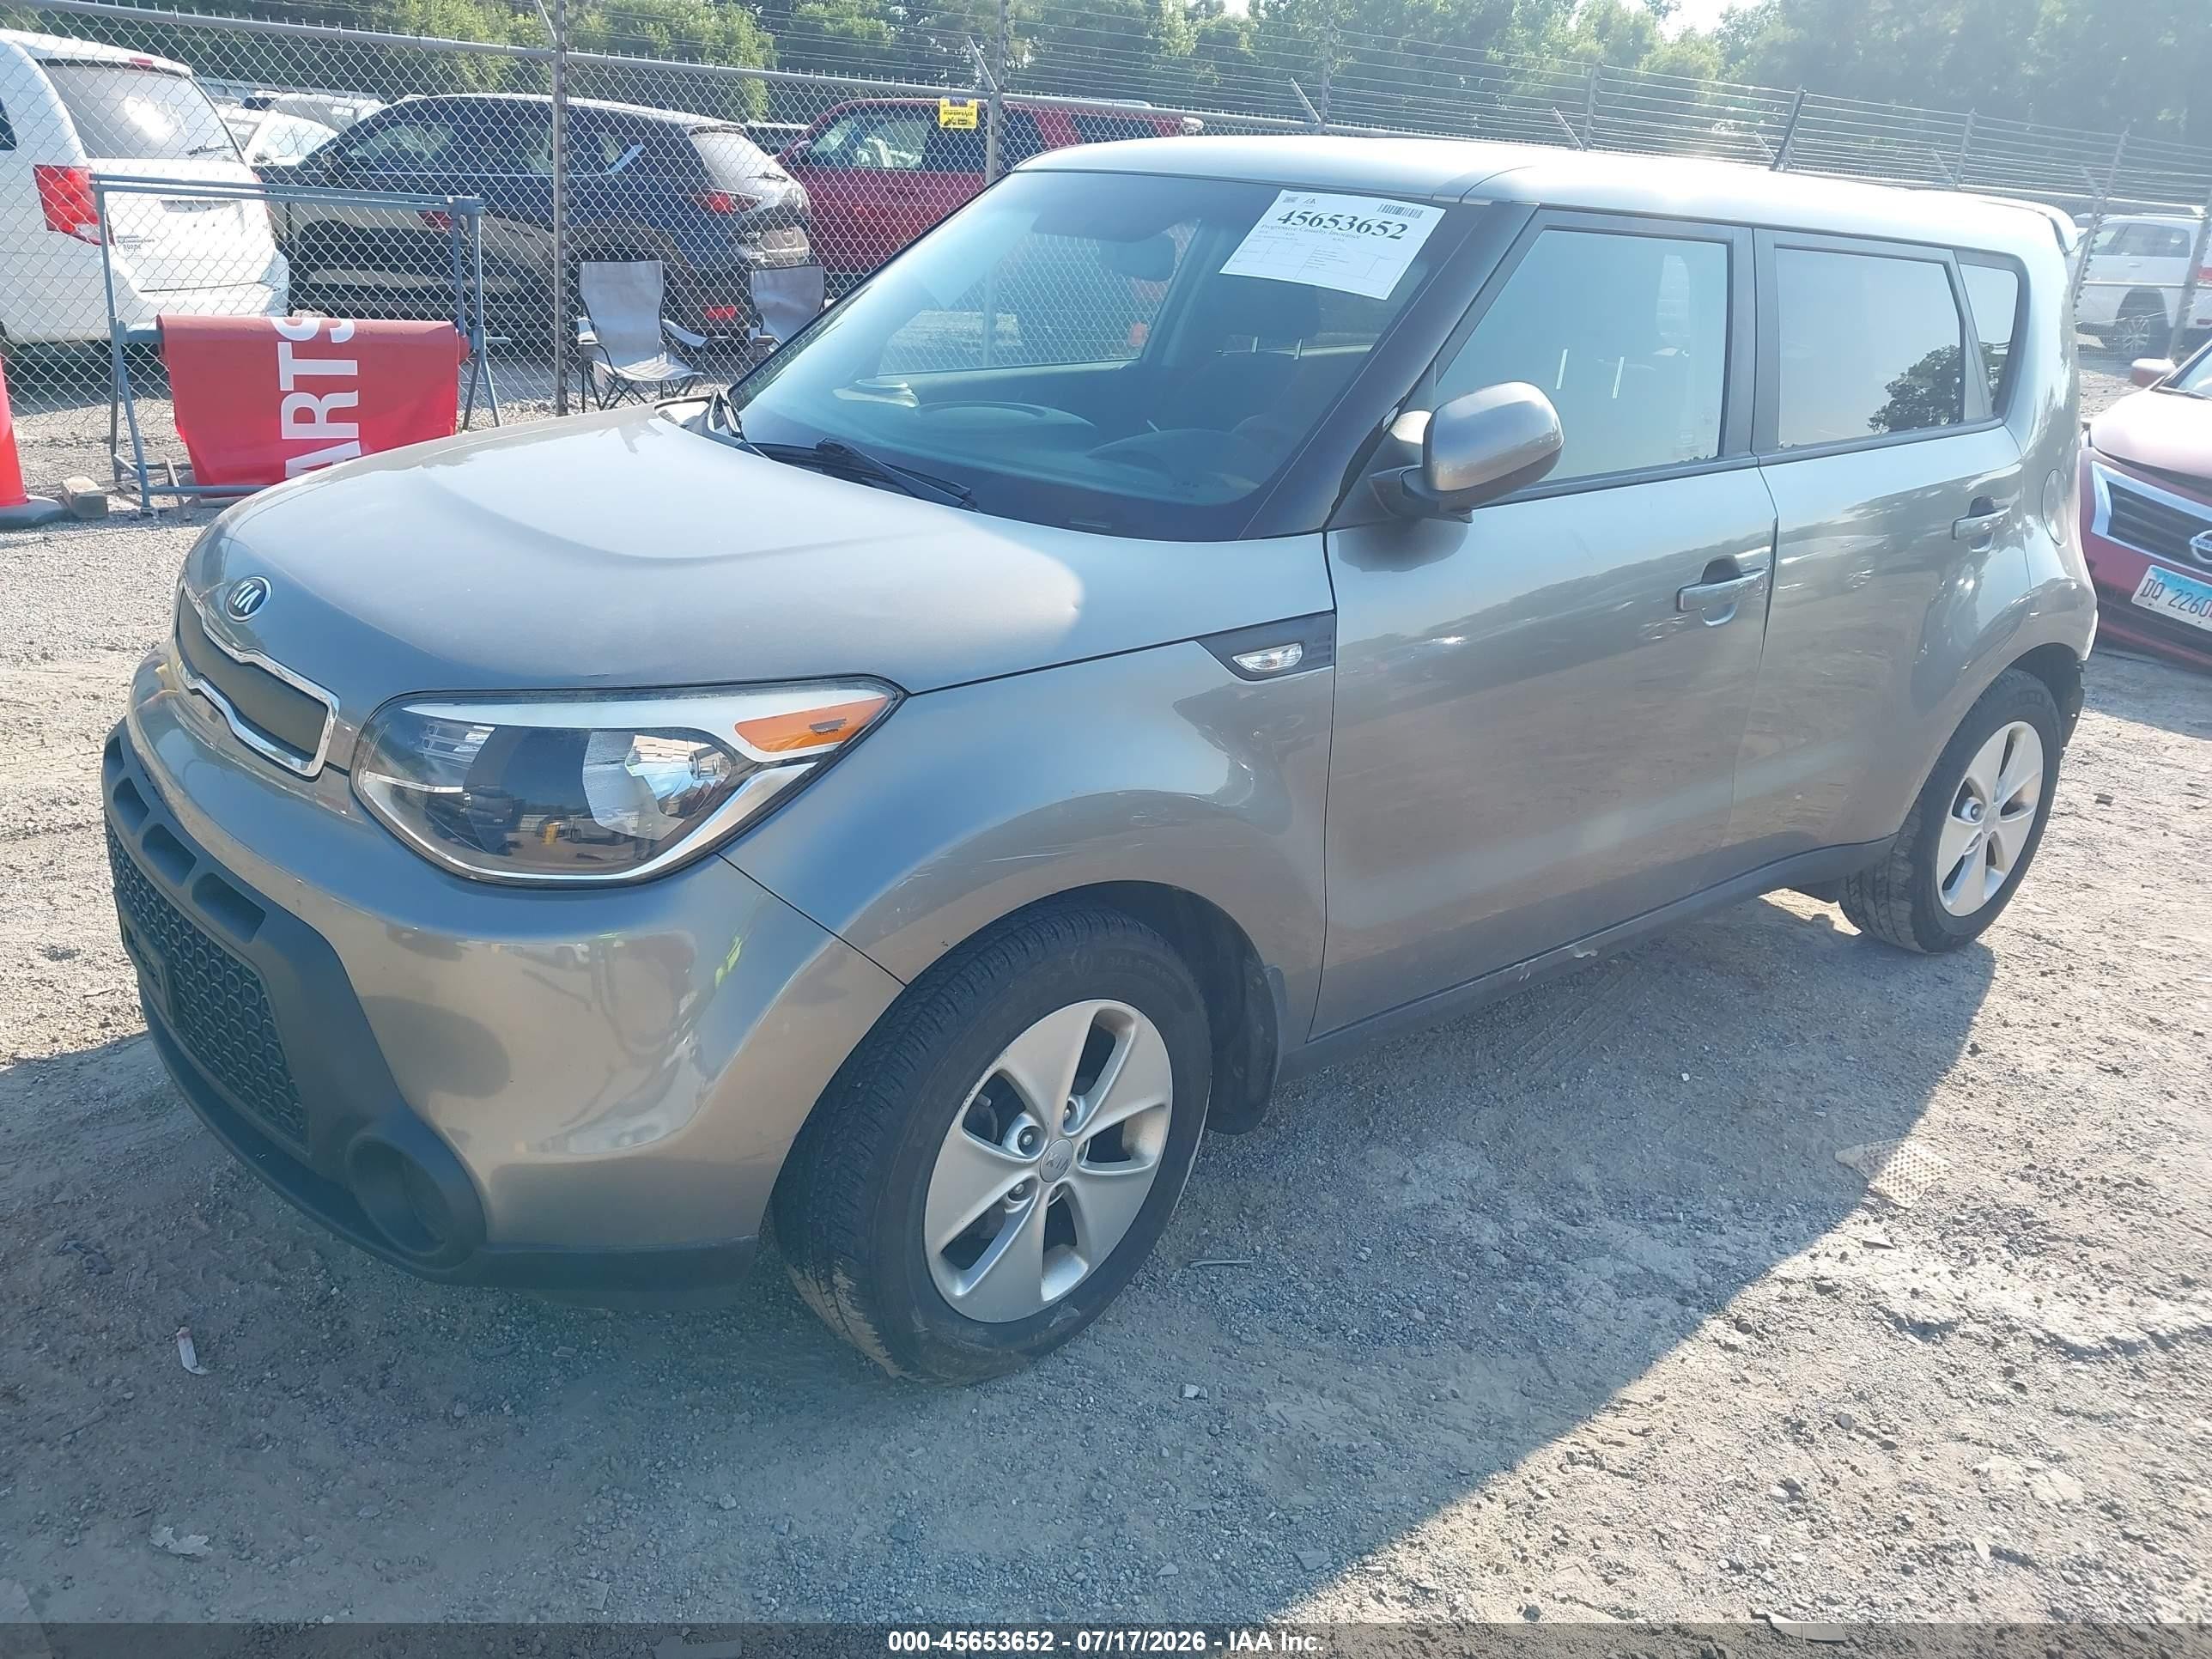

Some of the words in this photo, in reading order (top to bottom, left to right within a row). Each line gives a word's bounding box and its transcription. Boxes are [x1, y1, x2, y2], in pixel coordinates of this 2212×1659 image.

[1278, 210, 1408, 240] 45653652
[2140, 579, 2166, 601] DQ
[2168, 588, 2212, 617] 2260
[1046, 1152, 1069, 1171] KIA
